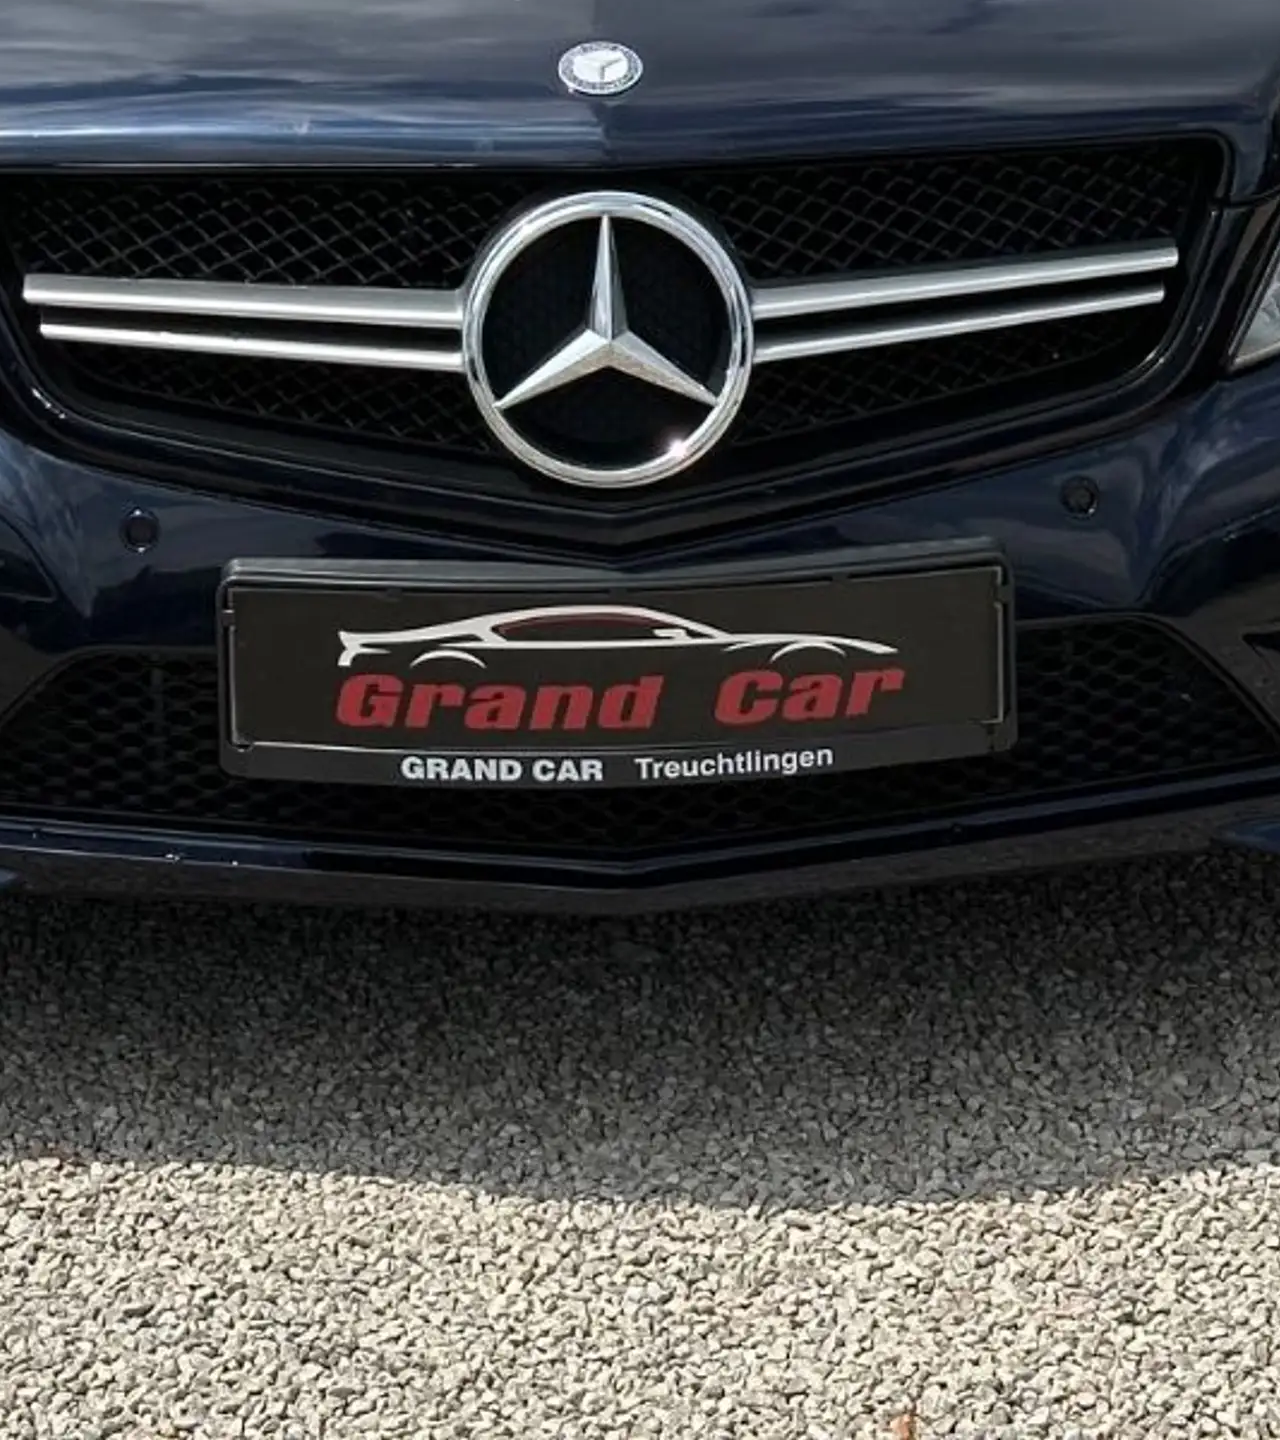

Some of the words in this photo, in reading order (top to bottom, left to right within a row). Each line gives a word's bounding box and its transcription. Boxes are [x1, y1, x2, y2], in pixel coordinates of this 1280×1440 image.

[336, 674, 665, 730] Grand
[714, 668, 905, 725] Car
[401, 757, 522, 782] GRAND
[532, 758, 603, 781] CAR
[635, 747, 833, 780] Treuchtlingen
